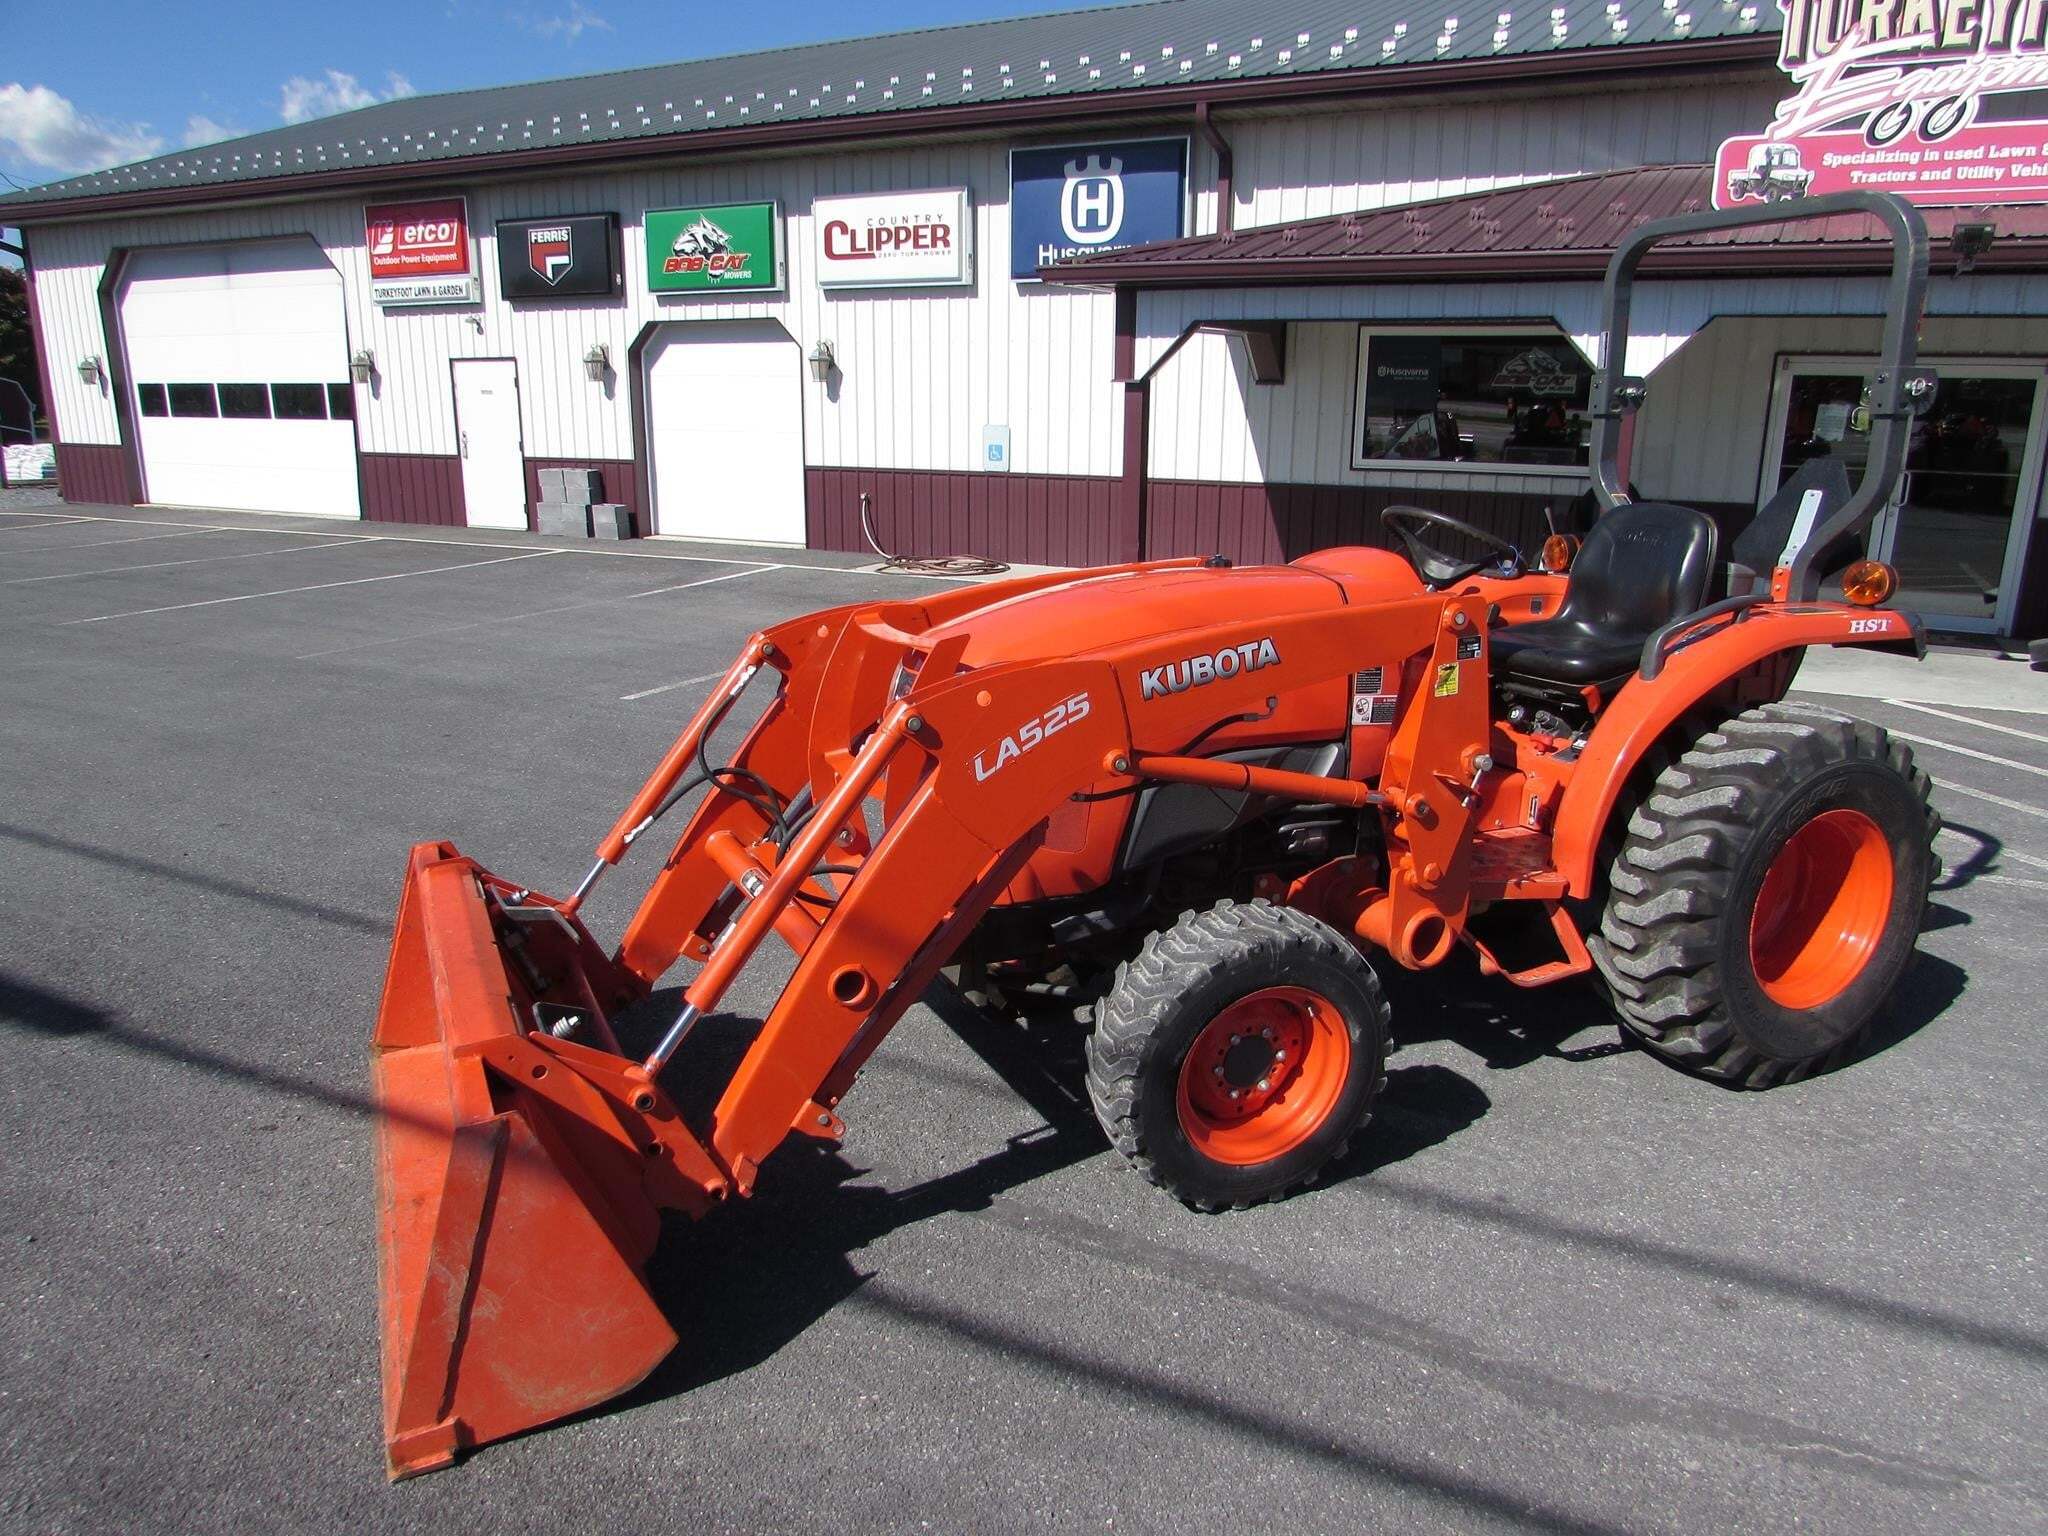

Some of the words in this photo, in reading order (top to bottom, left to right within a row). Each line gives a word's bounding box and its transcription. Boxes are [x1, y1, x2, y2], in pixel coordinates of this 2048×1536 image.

[1822, 149, 1920, 168] Specializing
[1923, 149, 1939, 162] in
[1944, 146, 1985, 161] used
[1988, 144, 2036, 159] Lawn
[1850, 169, 1917, 184] Tractors
[1920, 168, 1952, 181] and
[1956, 165, 2006, 181] Utility
[866, 214, 943, 227] COUNTRY
[531, 230, 569, 243] FERRIS
[823, 219, 951, 261] CLIPPER
[374, 255, 400, 266] Outdoor
[401, 255, 420, 264] Power
[421, 252, 457, 264] Equipment
[664, 252, 751, 274] BOB-CAT
[724, 270, 752, 280] MOWERS
[374, 288, 412, 298] TURKEYFOOT
[414, 286, 431, 296] LAWN
[440, 285, 464, 296] GARDEN
[1848, 619, 1891, 633] HST
[1140, 637, 1280, 701] KUBOTA
[973, 691, 1092, 784] LA525
